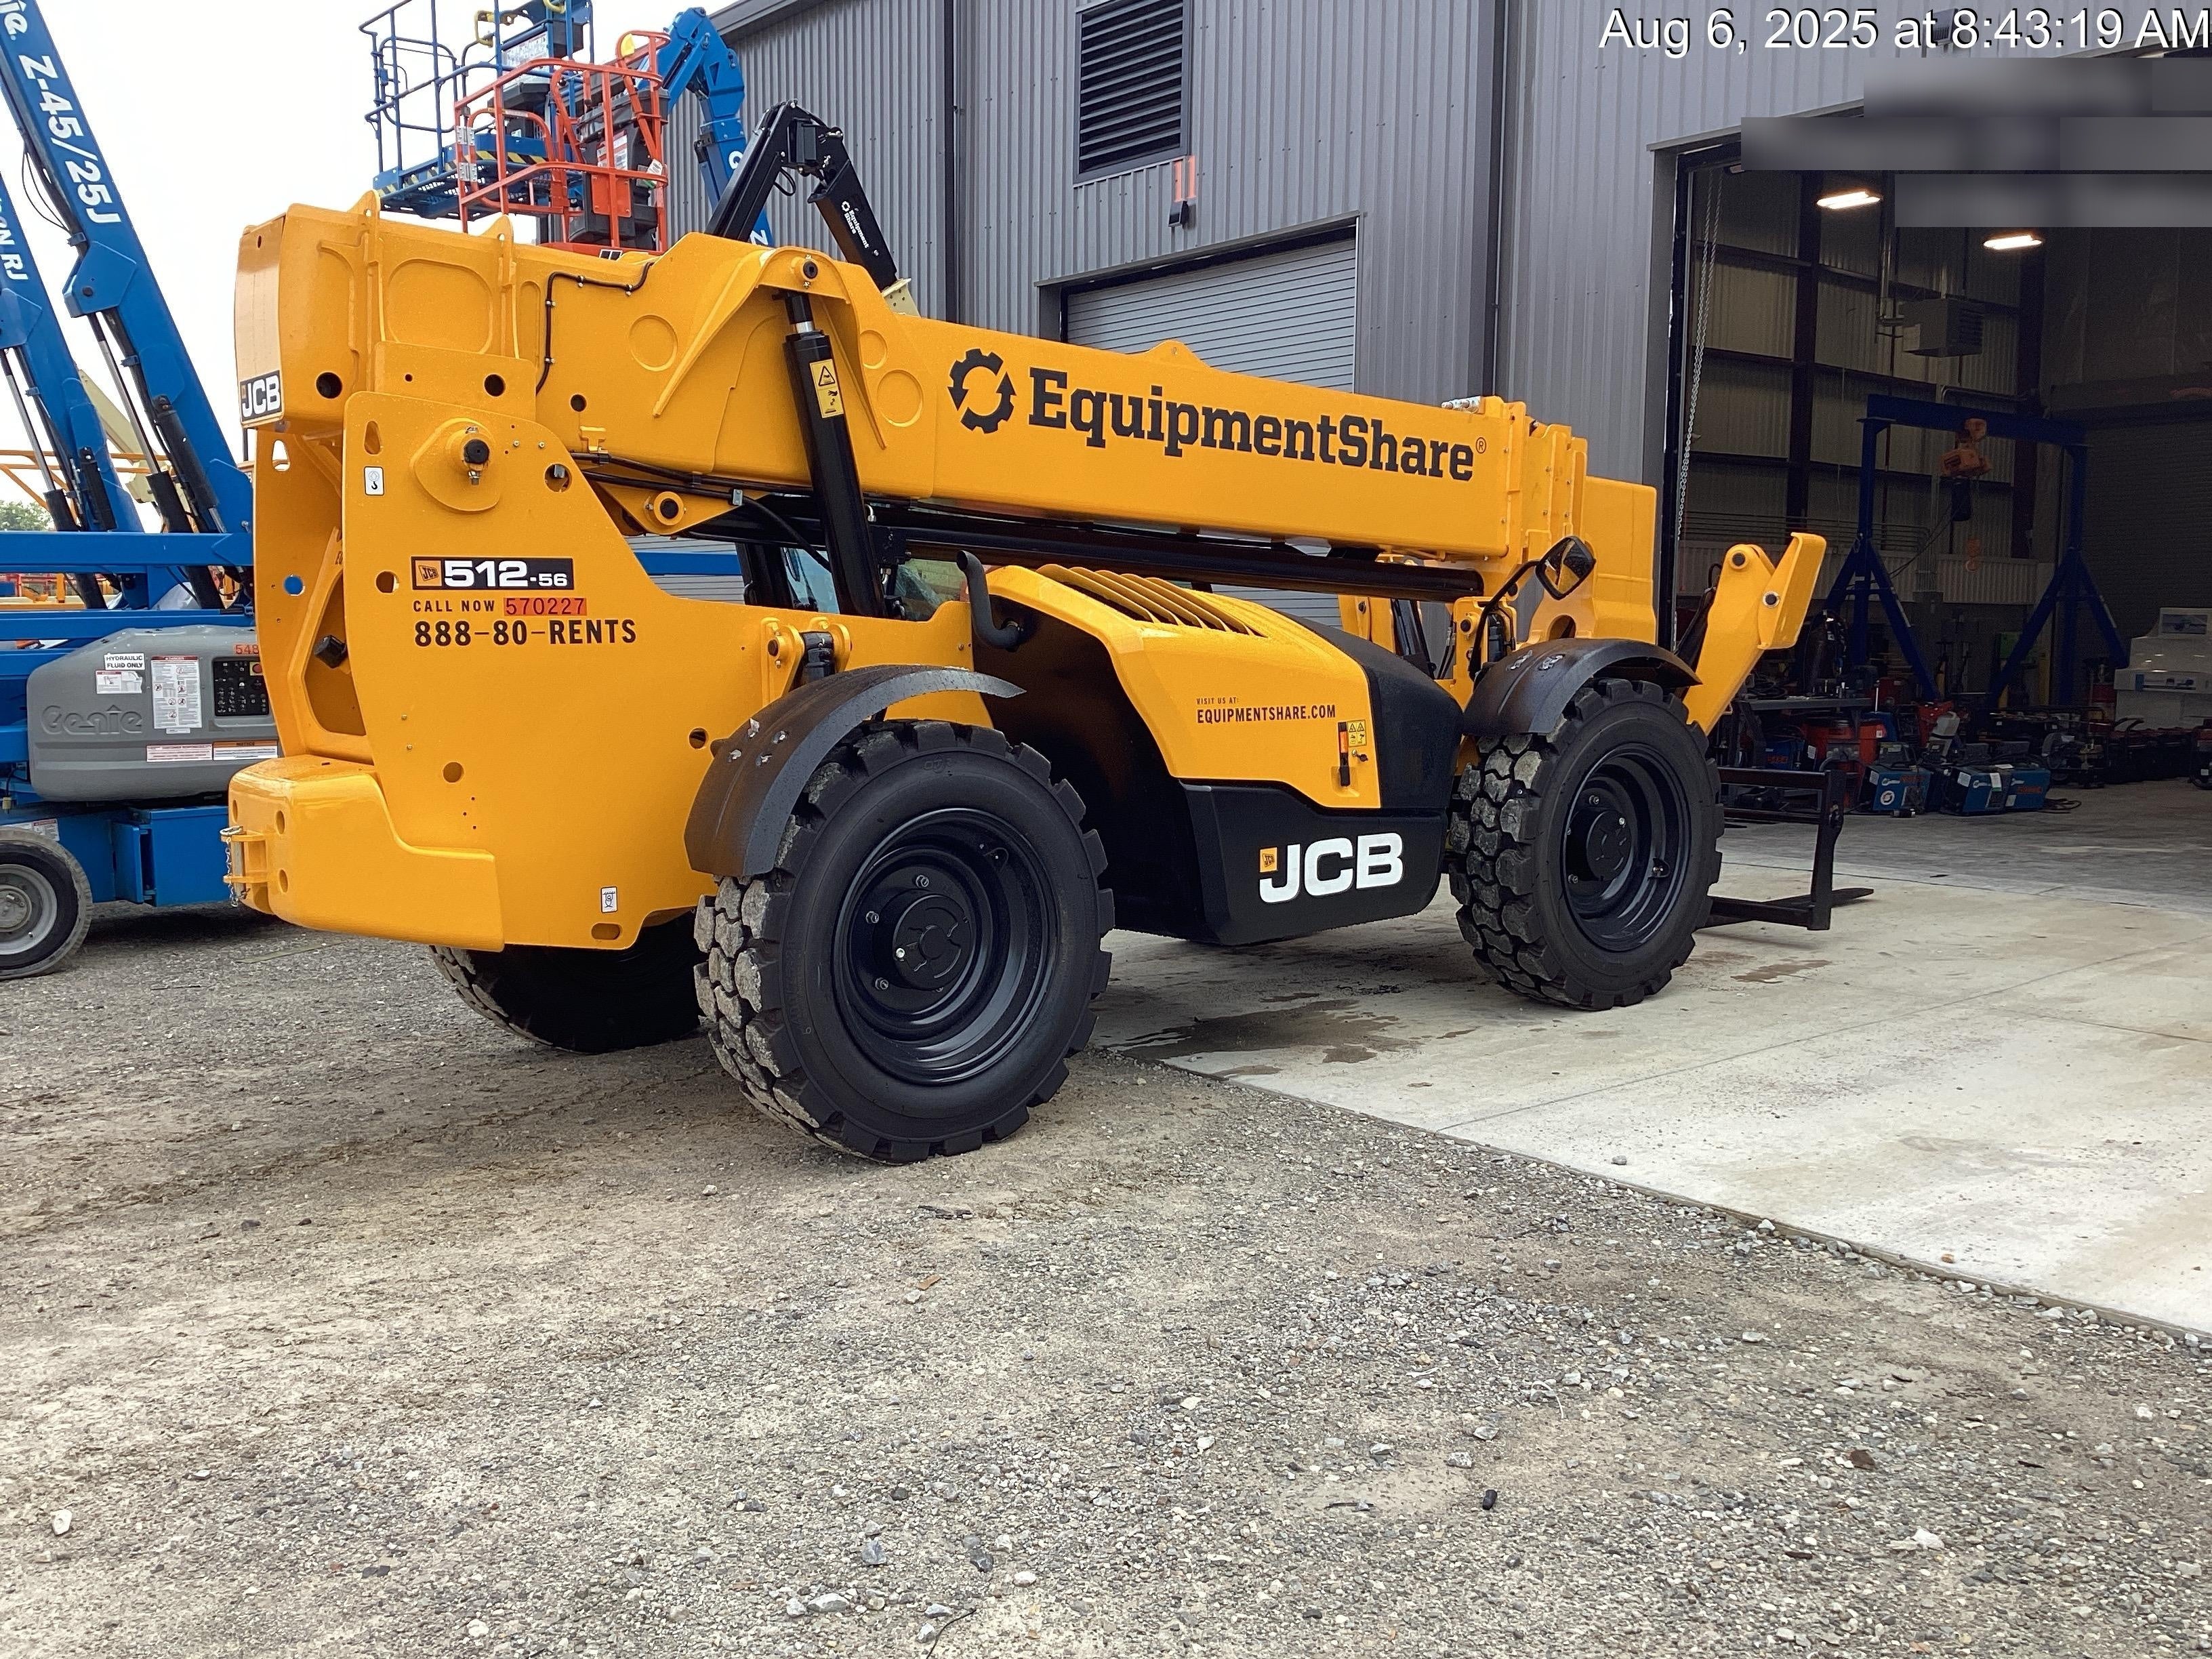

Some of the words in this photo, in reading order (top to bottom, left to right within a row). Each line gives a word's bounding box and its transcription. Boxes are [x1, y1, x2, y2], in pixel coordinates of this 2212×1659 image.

[18, 55, 122, 224] Z-45/25J
[241, 375, 281, 417] JCB
[422, 567, 439, 579] JCB
[444, 560, 568, 588] 512-56
[413, 600, 453, 613] CALL
[461, 600, 495, 612] NOW
[506, 597, 585, 615] 570227
[414, 619, 637, 647] 888-80-RENTS
[41, 704, 143, 735] Genie
[1197, 705, 1336, 724] EQUIPMENTSHARE.COM
[1259, 832, 1403, 903] JCB
